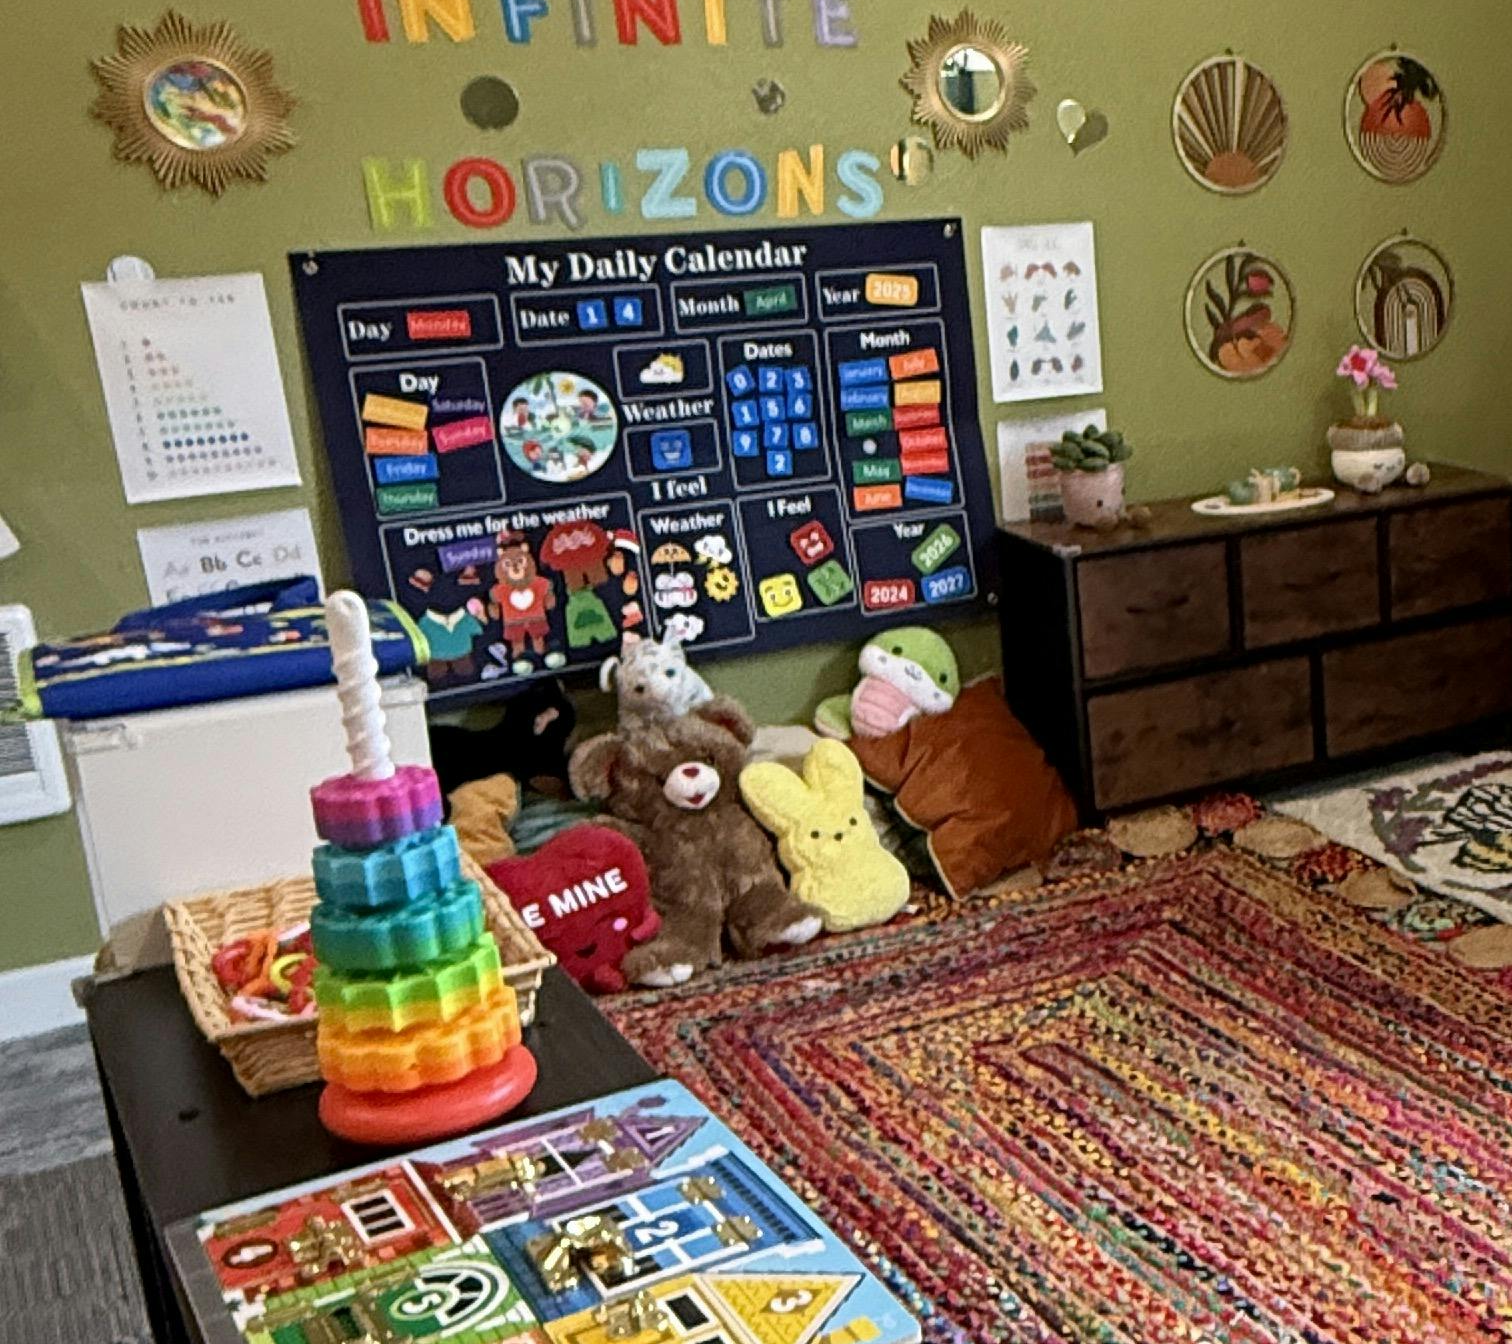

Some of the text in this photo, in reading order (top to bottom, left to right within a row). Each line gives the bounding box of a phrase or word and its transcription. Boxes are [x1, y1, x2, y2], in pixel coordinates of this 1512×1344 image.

[362, 144, 885, 232] HORIZONS
[505, 240, 807, 288] My Daily Calendar
[823, 279, 912, 306] Year 2025
[519, 309, 570, 330] Date
[621, 302, 635, 320] 4
[679, 294, 740, 317] Month
[348, 320, 393, 341] Day
[860, 330, 911, 350] Month
[744, 342, 793, 361] Dates
[399, 372, 440, 393] Day
[766, 372, 778, 388] 2
[622, 398, 714, 424] Weather
[651, 475, 708, 501] I feel
[767, 495, 811, 518] I Feel
[404, 502, 610, 546] Dress me for the weather
[650, 512, 725, 535] Weather
[892, 522, 926, 539] Year
[200, 554, 227, 573] Bb
[236, 548, 264, 567] Cc
[919, 533, 955, 567] 2026
[870, 573, 965, 603] 2024 2027
[522, 867, 628, 928] E MINE
[633, 1218, 679, 1243] 2
[769, 1288, 814, 1313] 3
